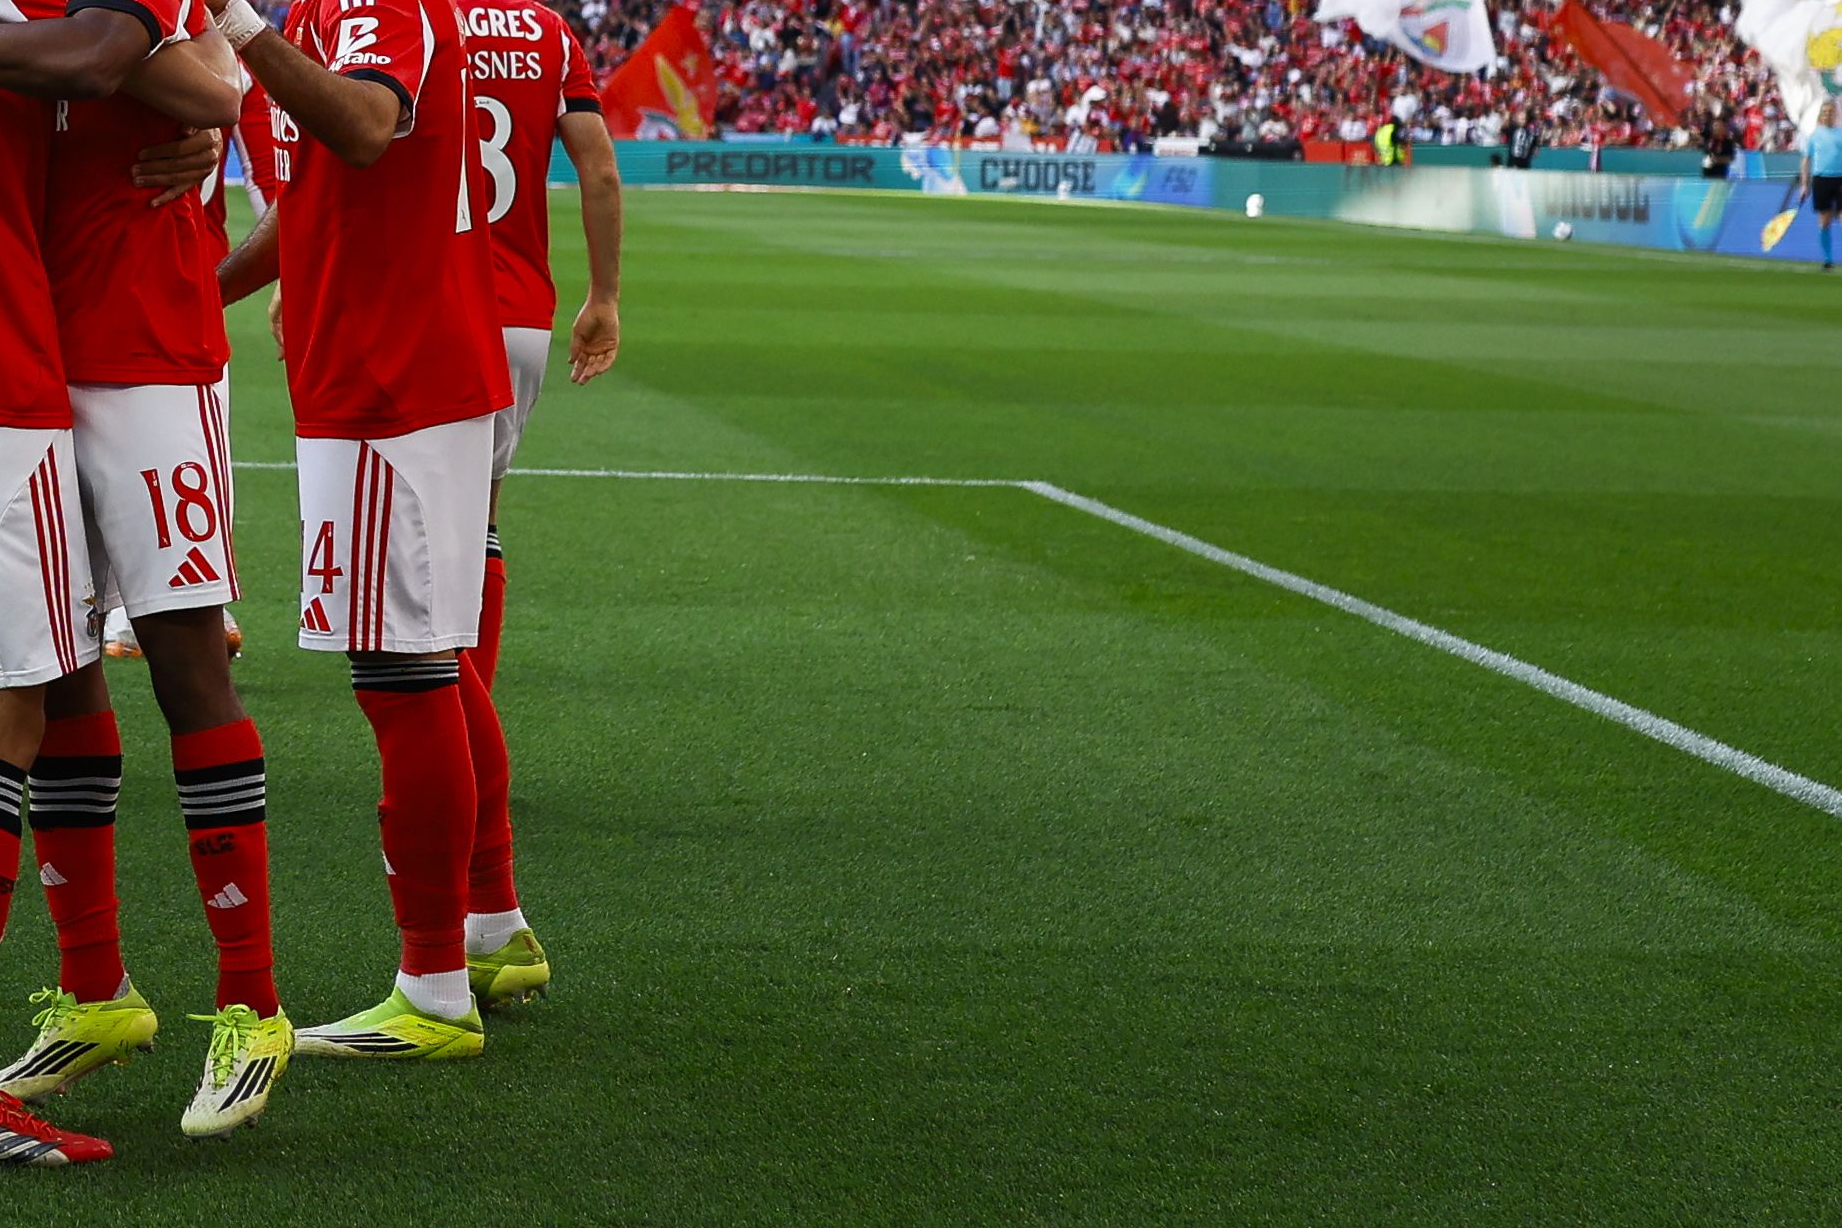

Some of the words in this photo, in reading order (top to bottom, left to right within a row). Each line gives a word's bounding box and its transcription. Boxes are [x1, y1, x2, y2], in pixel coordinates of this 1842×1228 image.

[666, 150, 877, 184] PREDATOR
[980, 155, 1098, 193] CHOOSE
[139, 461, 217, 550] 18
